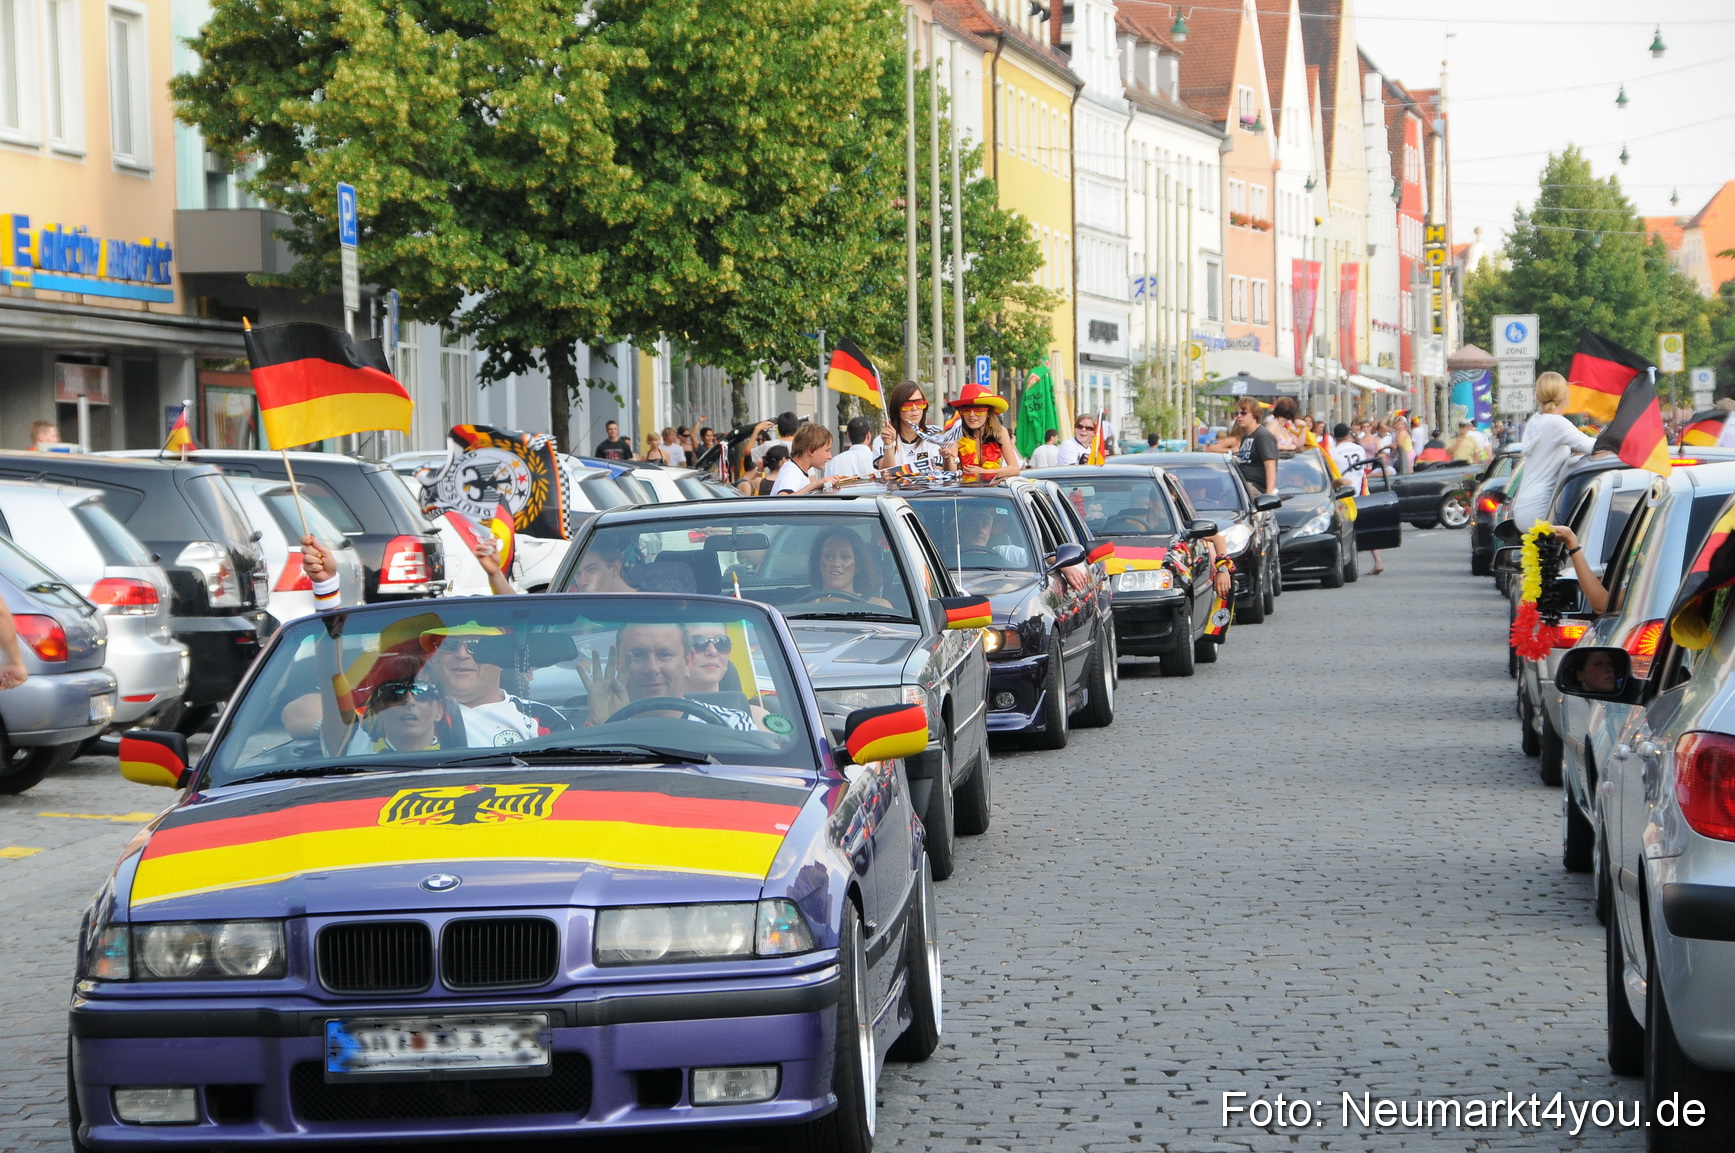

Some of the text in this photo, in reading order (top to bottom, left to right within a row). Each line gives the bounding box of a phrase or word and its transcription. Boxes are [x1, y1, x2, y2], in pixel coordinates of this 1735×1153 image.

[341, 191, 353, 237] P
[1426, 225, 1446, 335] HOTEL
[1505, 347, 1529, 355] ZONE
[979, 360, 988, 383] P
